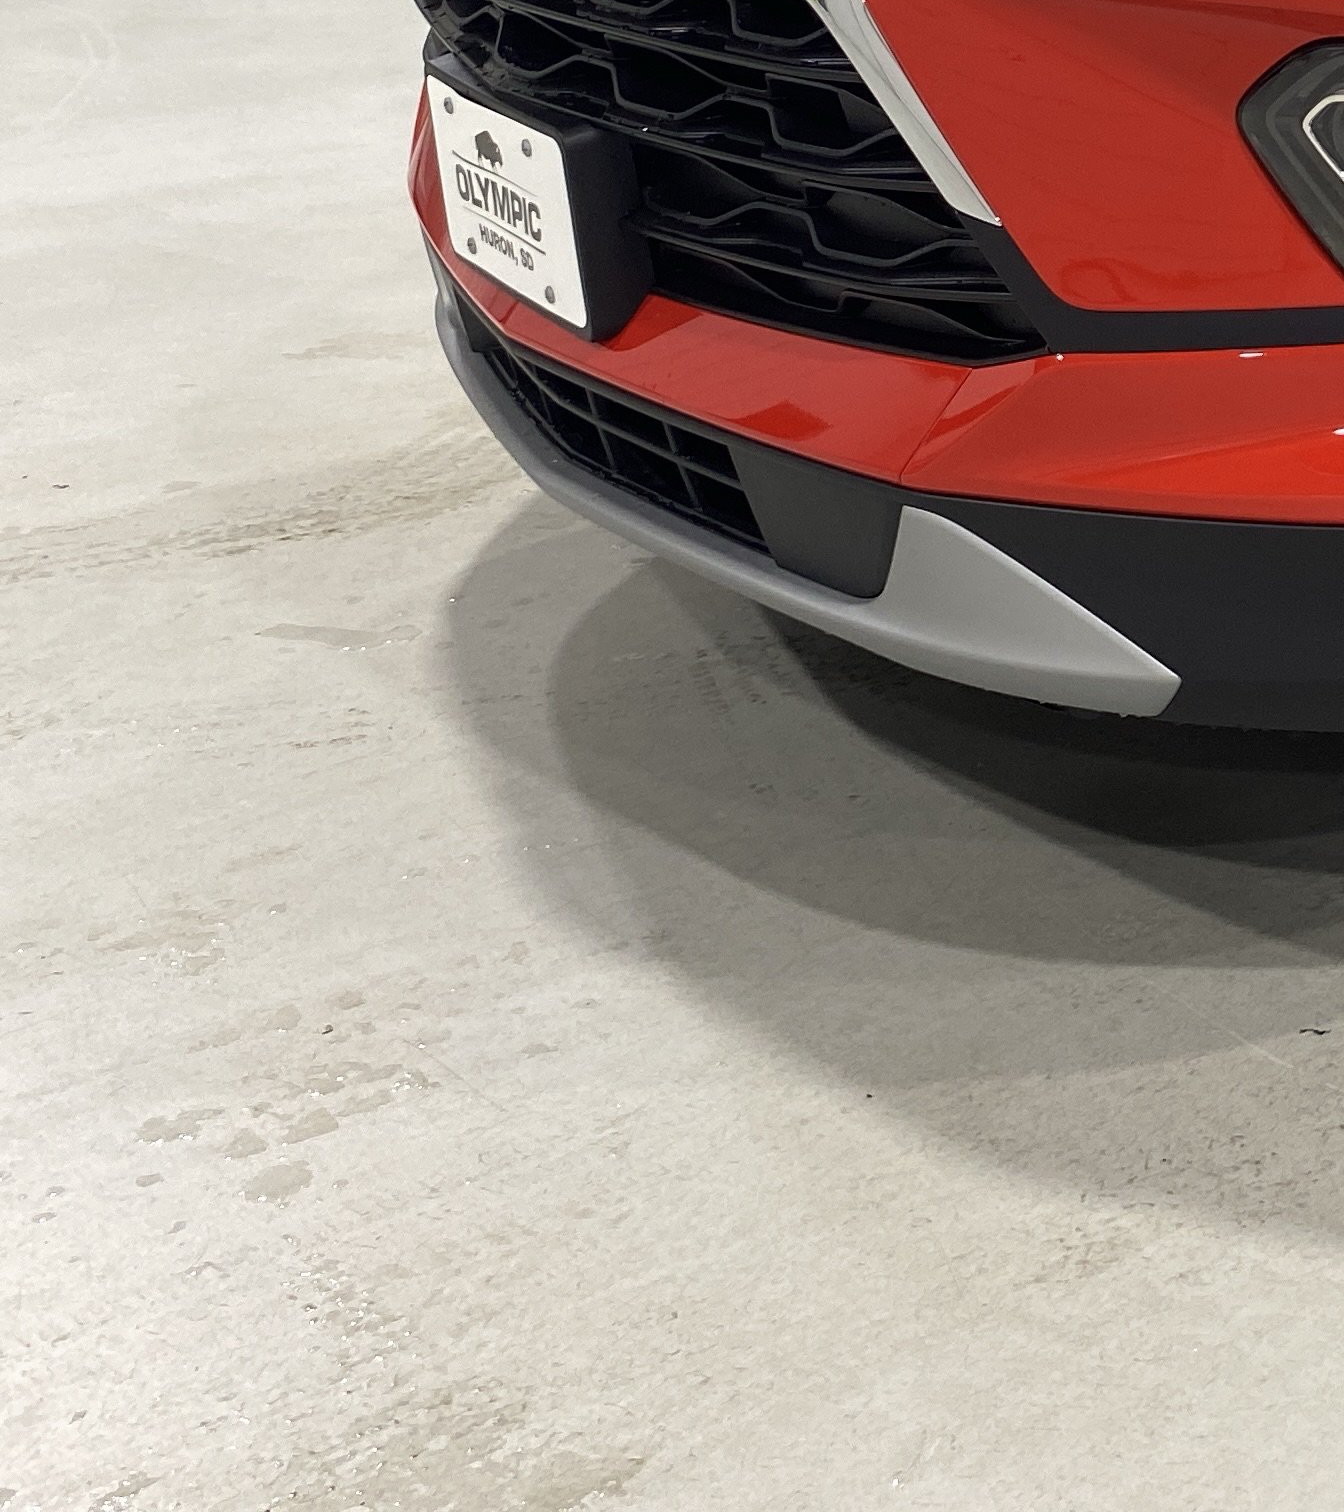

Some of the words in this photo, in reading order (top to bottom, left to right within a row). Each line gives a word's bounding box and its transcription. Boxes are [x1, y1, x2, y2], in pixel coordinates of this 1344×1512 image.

[455, 163, 542, 243] OLYMPIC
[479, 222, 518, 267] HURON,
[520, 247, 535, 272] SD
